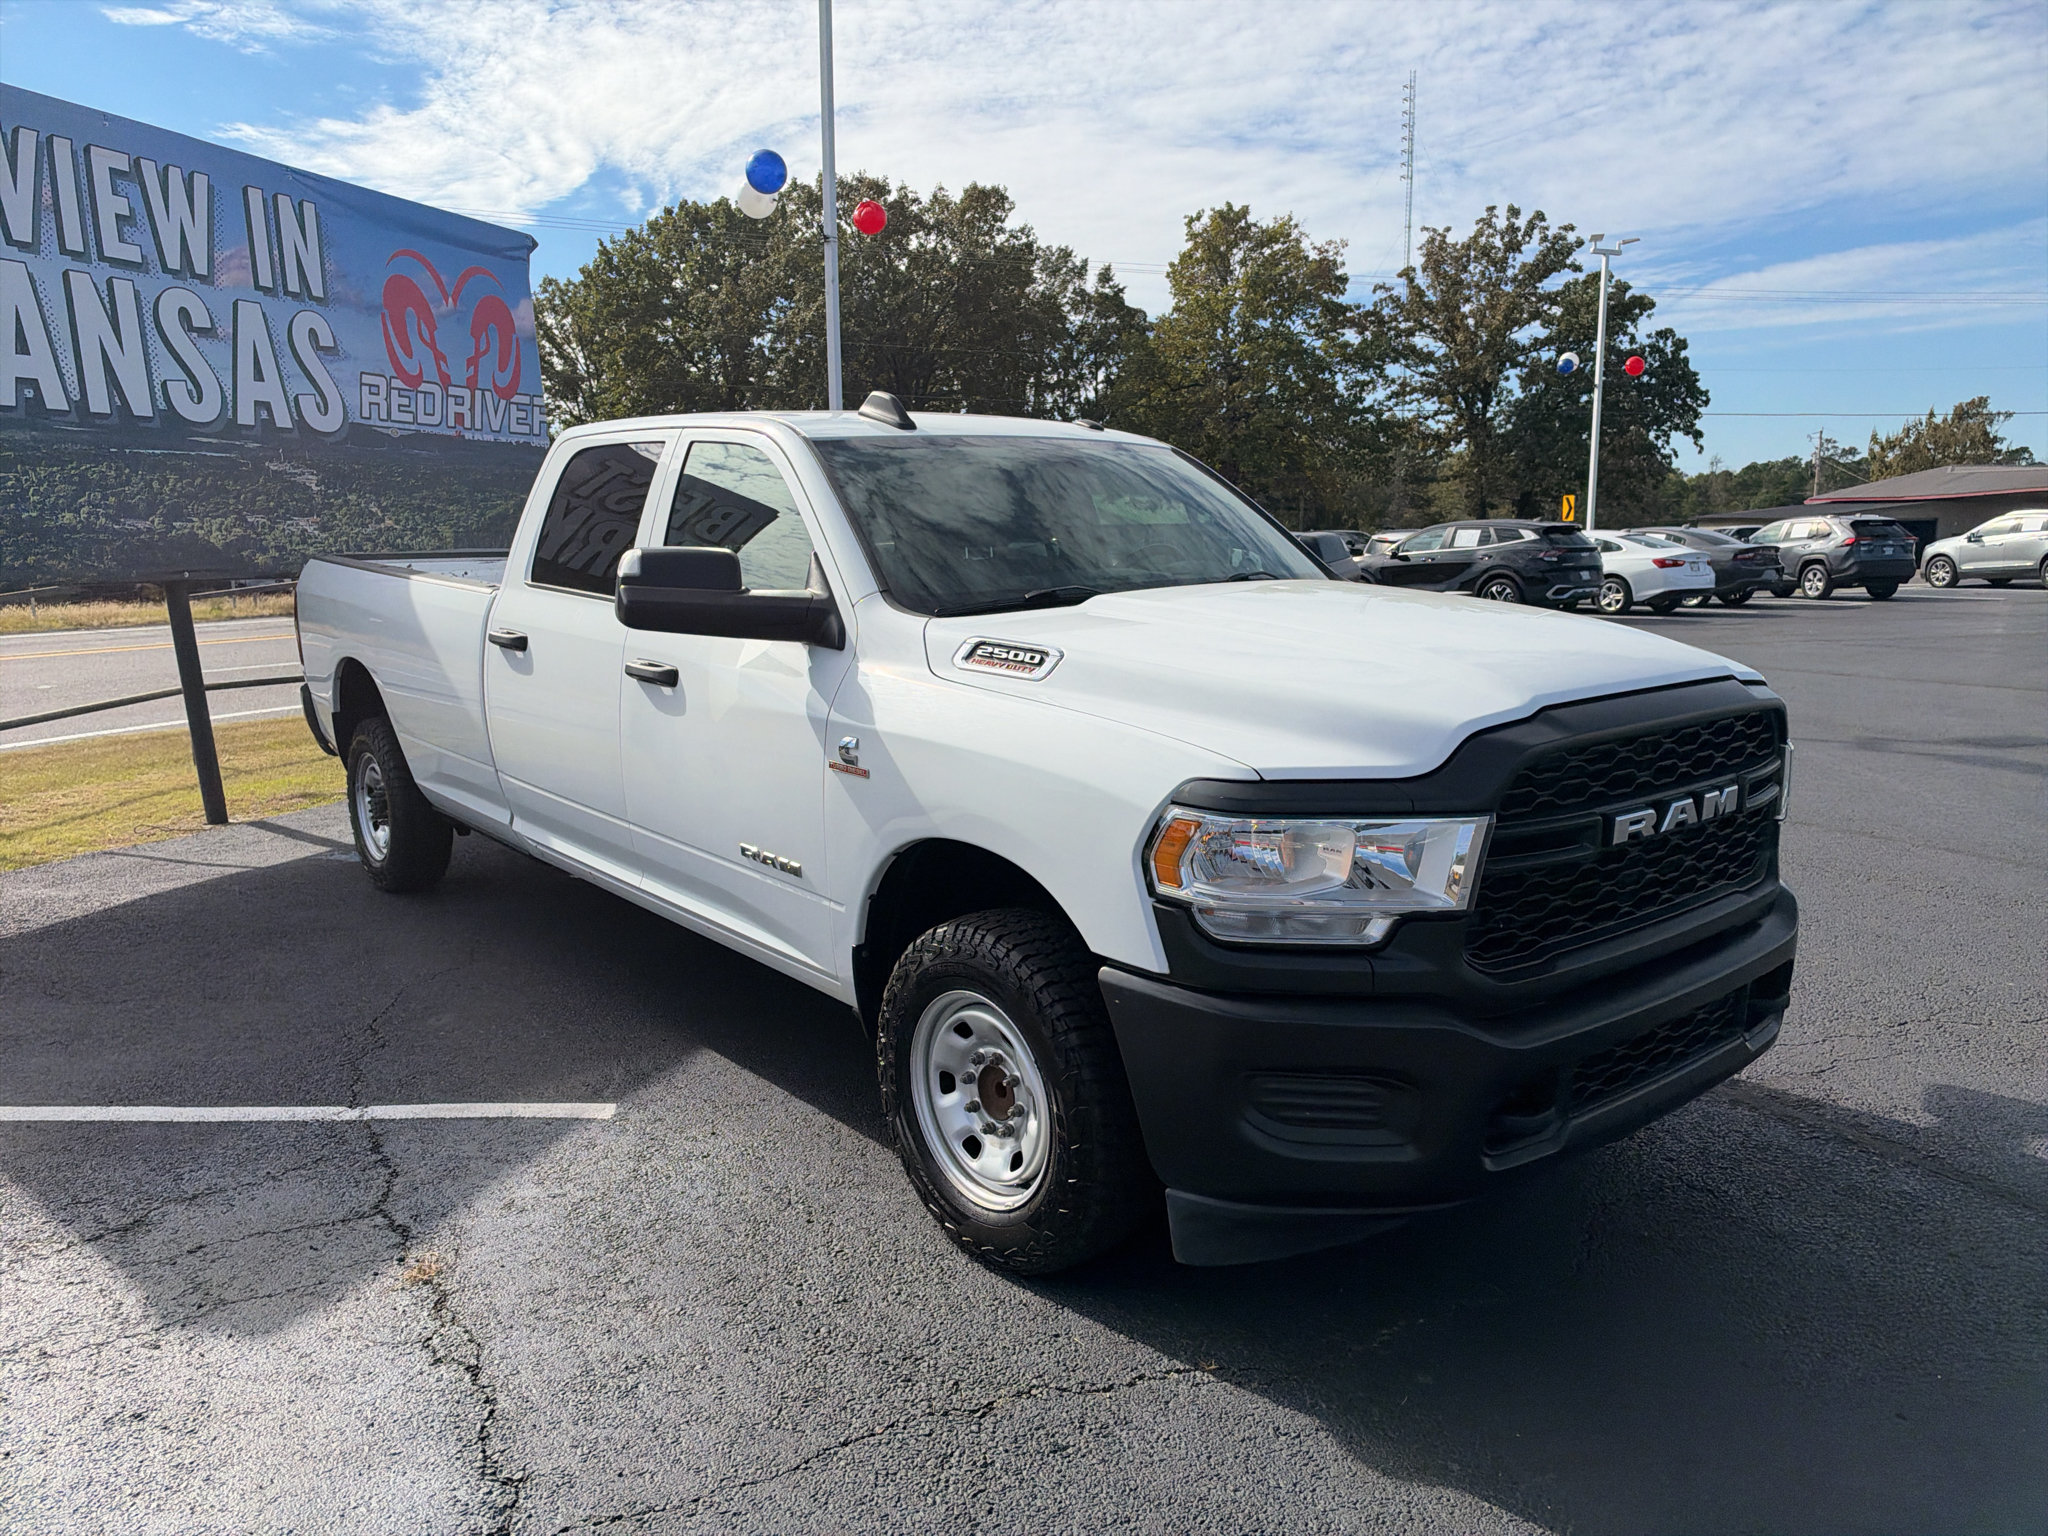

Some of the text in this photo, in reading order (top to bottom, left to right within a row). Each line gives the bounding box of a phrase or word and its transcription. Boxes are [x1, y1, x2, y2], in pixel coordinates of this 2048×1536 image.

[0, 126, 325, 299] VIEW IN
[971, 658, 1036, 673] HEAVY DUTY
[977, 646, 1041, 664] 2500
[1613, 785, 1739, 846] RAM
[740, 842, 803, 878] RAM
